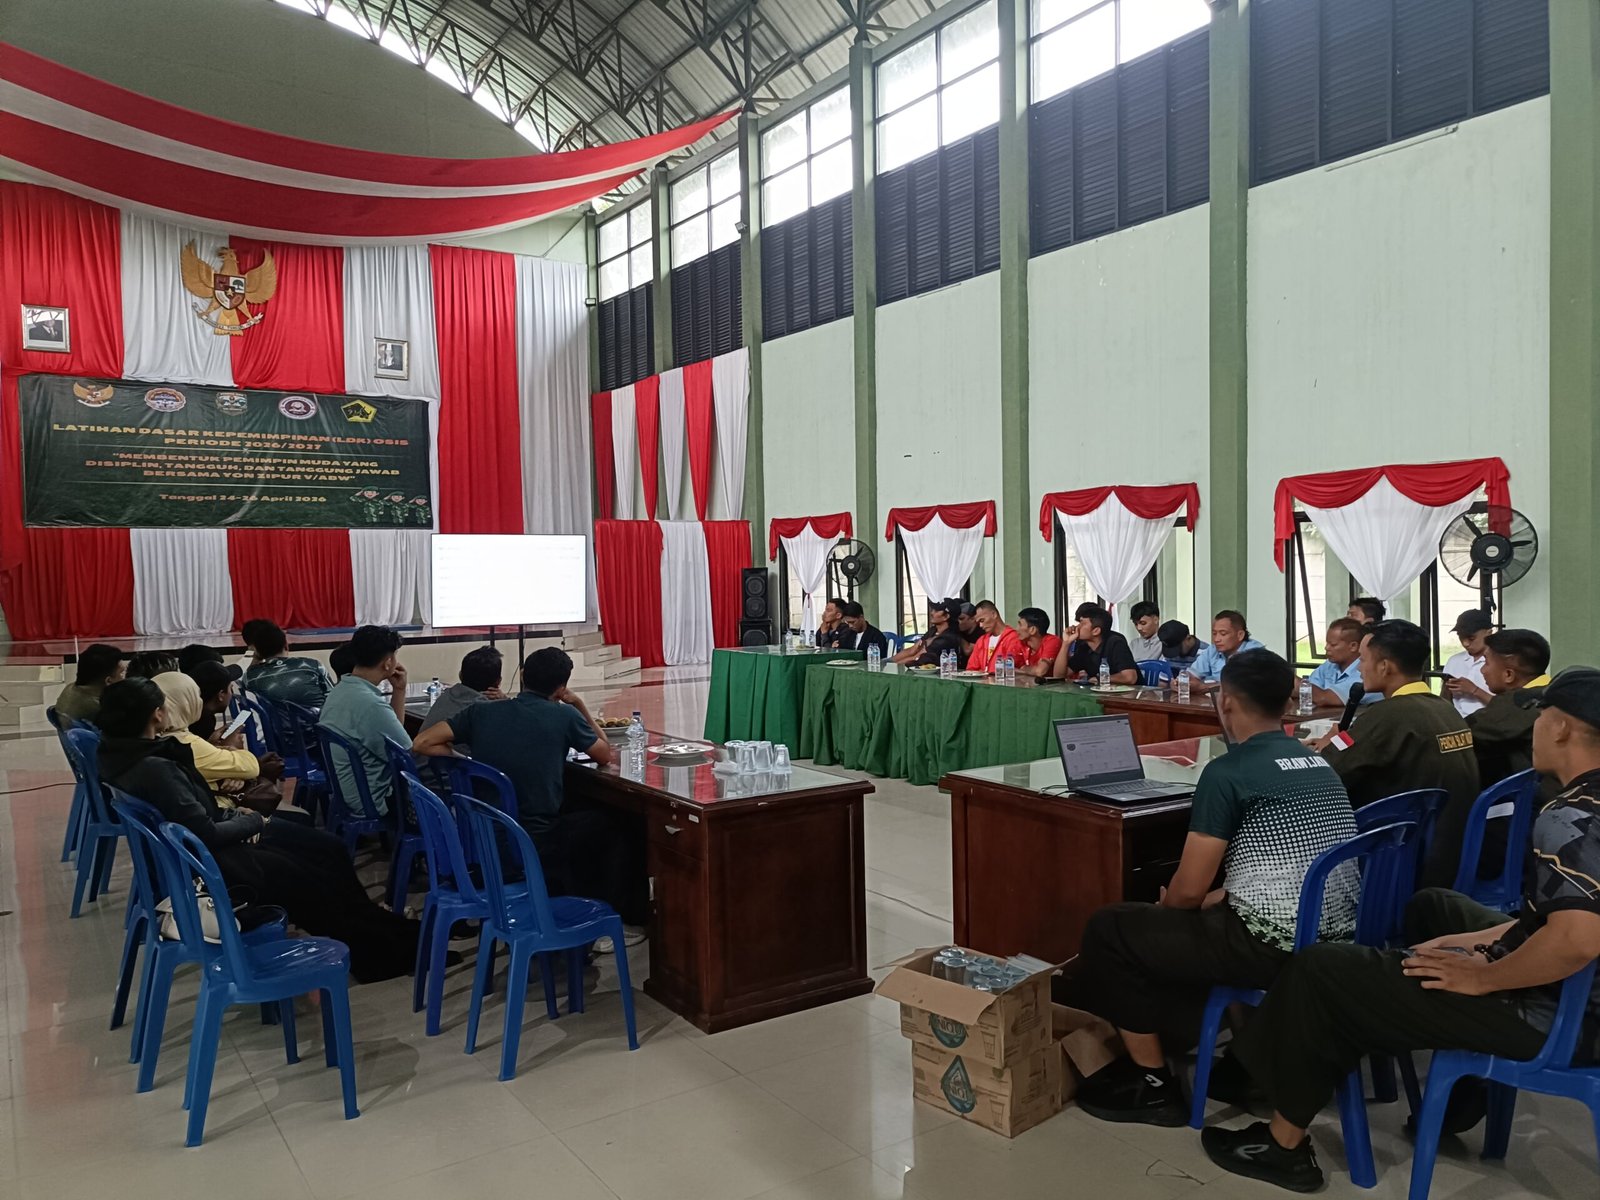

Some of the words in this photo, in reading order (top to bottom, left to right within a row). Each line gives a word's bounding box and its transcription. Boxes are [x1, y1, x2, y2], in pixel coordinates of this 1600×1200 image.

[53, 423, 136, 434] LATIHAN
[139, 426, 200, 437] DASAR
[202, 430, 331, 442] KEPEMIMPINAN
[332, 436, 371, 445] (LDK)
[373, 438, 409, 446] OSIS
[164, 437, 242, 447] PERIODE
[244, 440, 322, 450] 2026/2027
[85, 460, 162, 469] DISIPLIN,
[165, 462, 242, 471] TANGGUH,
[277, 466, 354, 475] TANGGUNG
[355, 468, 400, 476] JAWAB
[223, 456, 298, 465] PEMIMPIN
[300, 458, 342, 466] MUDA
[342, 460, 379, 468] YANG
[143, 470, 220, 478] BERSAMA
[257, 472, 302, 480] ZIPUR
[159, 493, 217, 502] Tanggal
[260, 495, 293, 503] April
